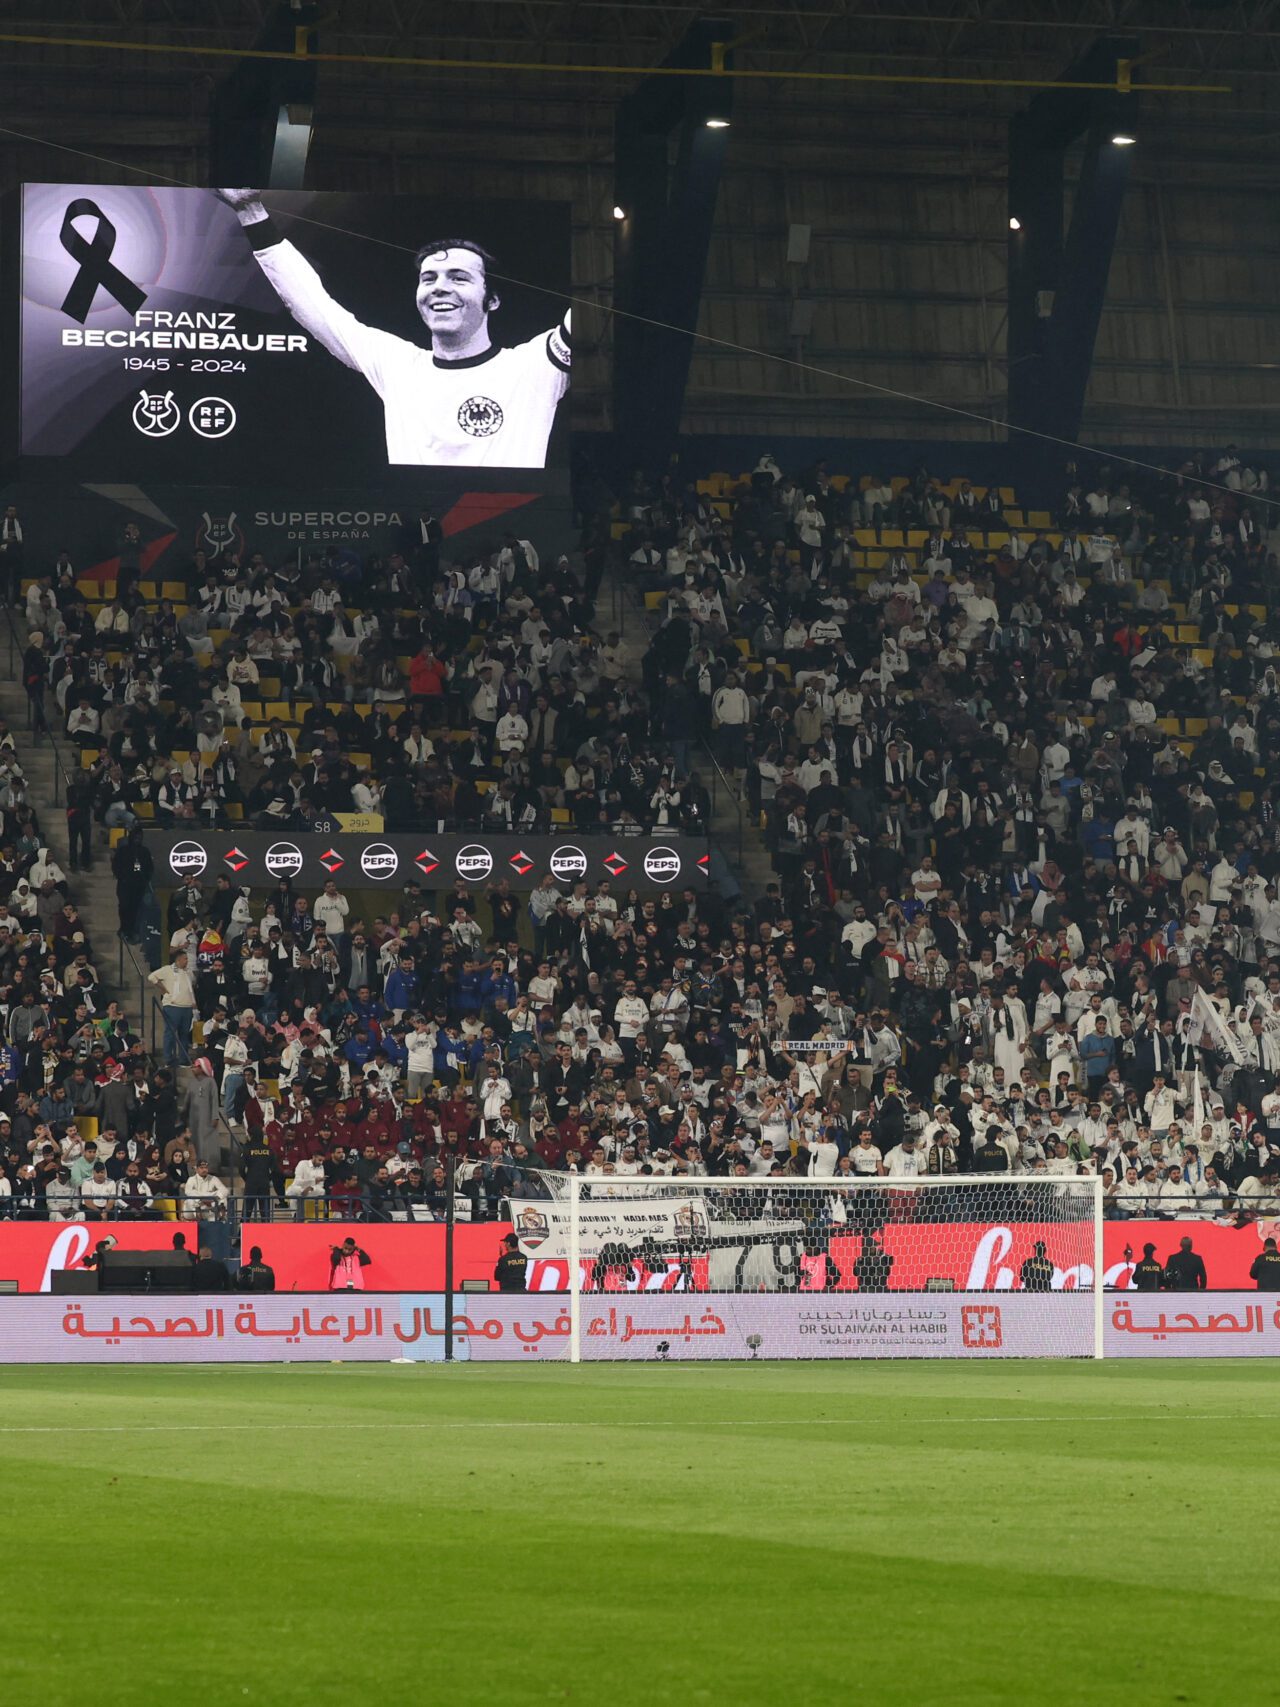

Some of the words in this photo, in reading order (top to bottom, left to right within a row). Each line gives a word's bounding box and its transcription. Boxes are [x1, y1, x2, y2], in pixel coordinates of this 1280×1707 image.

[136, 310, 236, 329] FRANZ
[62, 329, 308, 352] BECKENBAUER
[123, 358, 170, 370] 1945
[190, 360, 246, 372] 2024
[255, 512, 402, 526] SUPERCOPA
[288, 531, 306, 540] DE
[313, 528, 370, 539] ESPAÑA
[314, 822, 331, 833] S8
[172, 854, 204, 864] PEPSI
[268, 856, 300, 865] PEPSI
[364, 856, 396, 866] PEPSI
[458, 858, 490, 867] PEPSI
[552, 860, 585, 868] PEPSI
[646, 860, 678, 869] PEPSI
[62, 1304, 224, 1344] الصحية
[234, 1303, 383, 1343] الرعاية
[1112, 1301, 1264, 1339] الصحية
[821, 1324, 886, 1334] SULAIMAN
[890, 1324, 905, 1334] AL
[910, 1324, 948, 1334] HABIB
